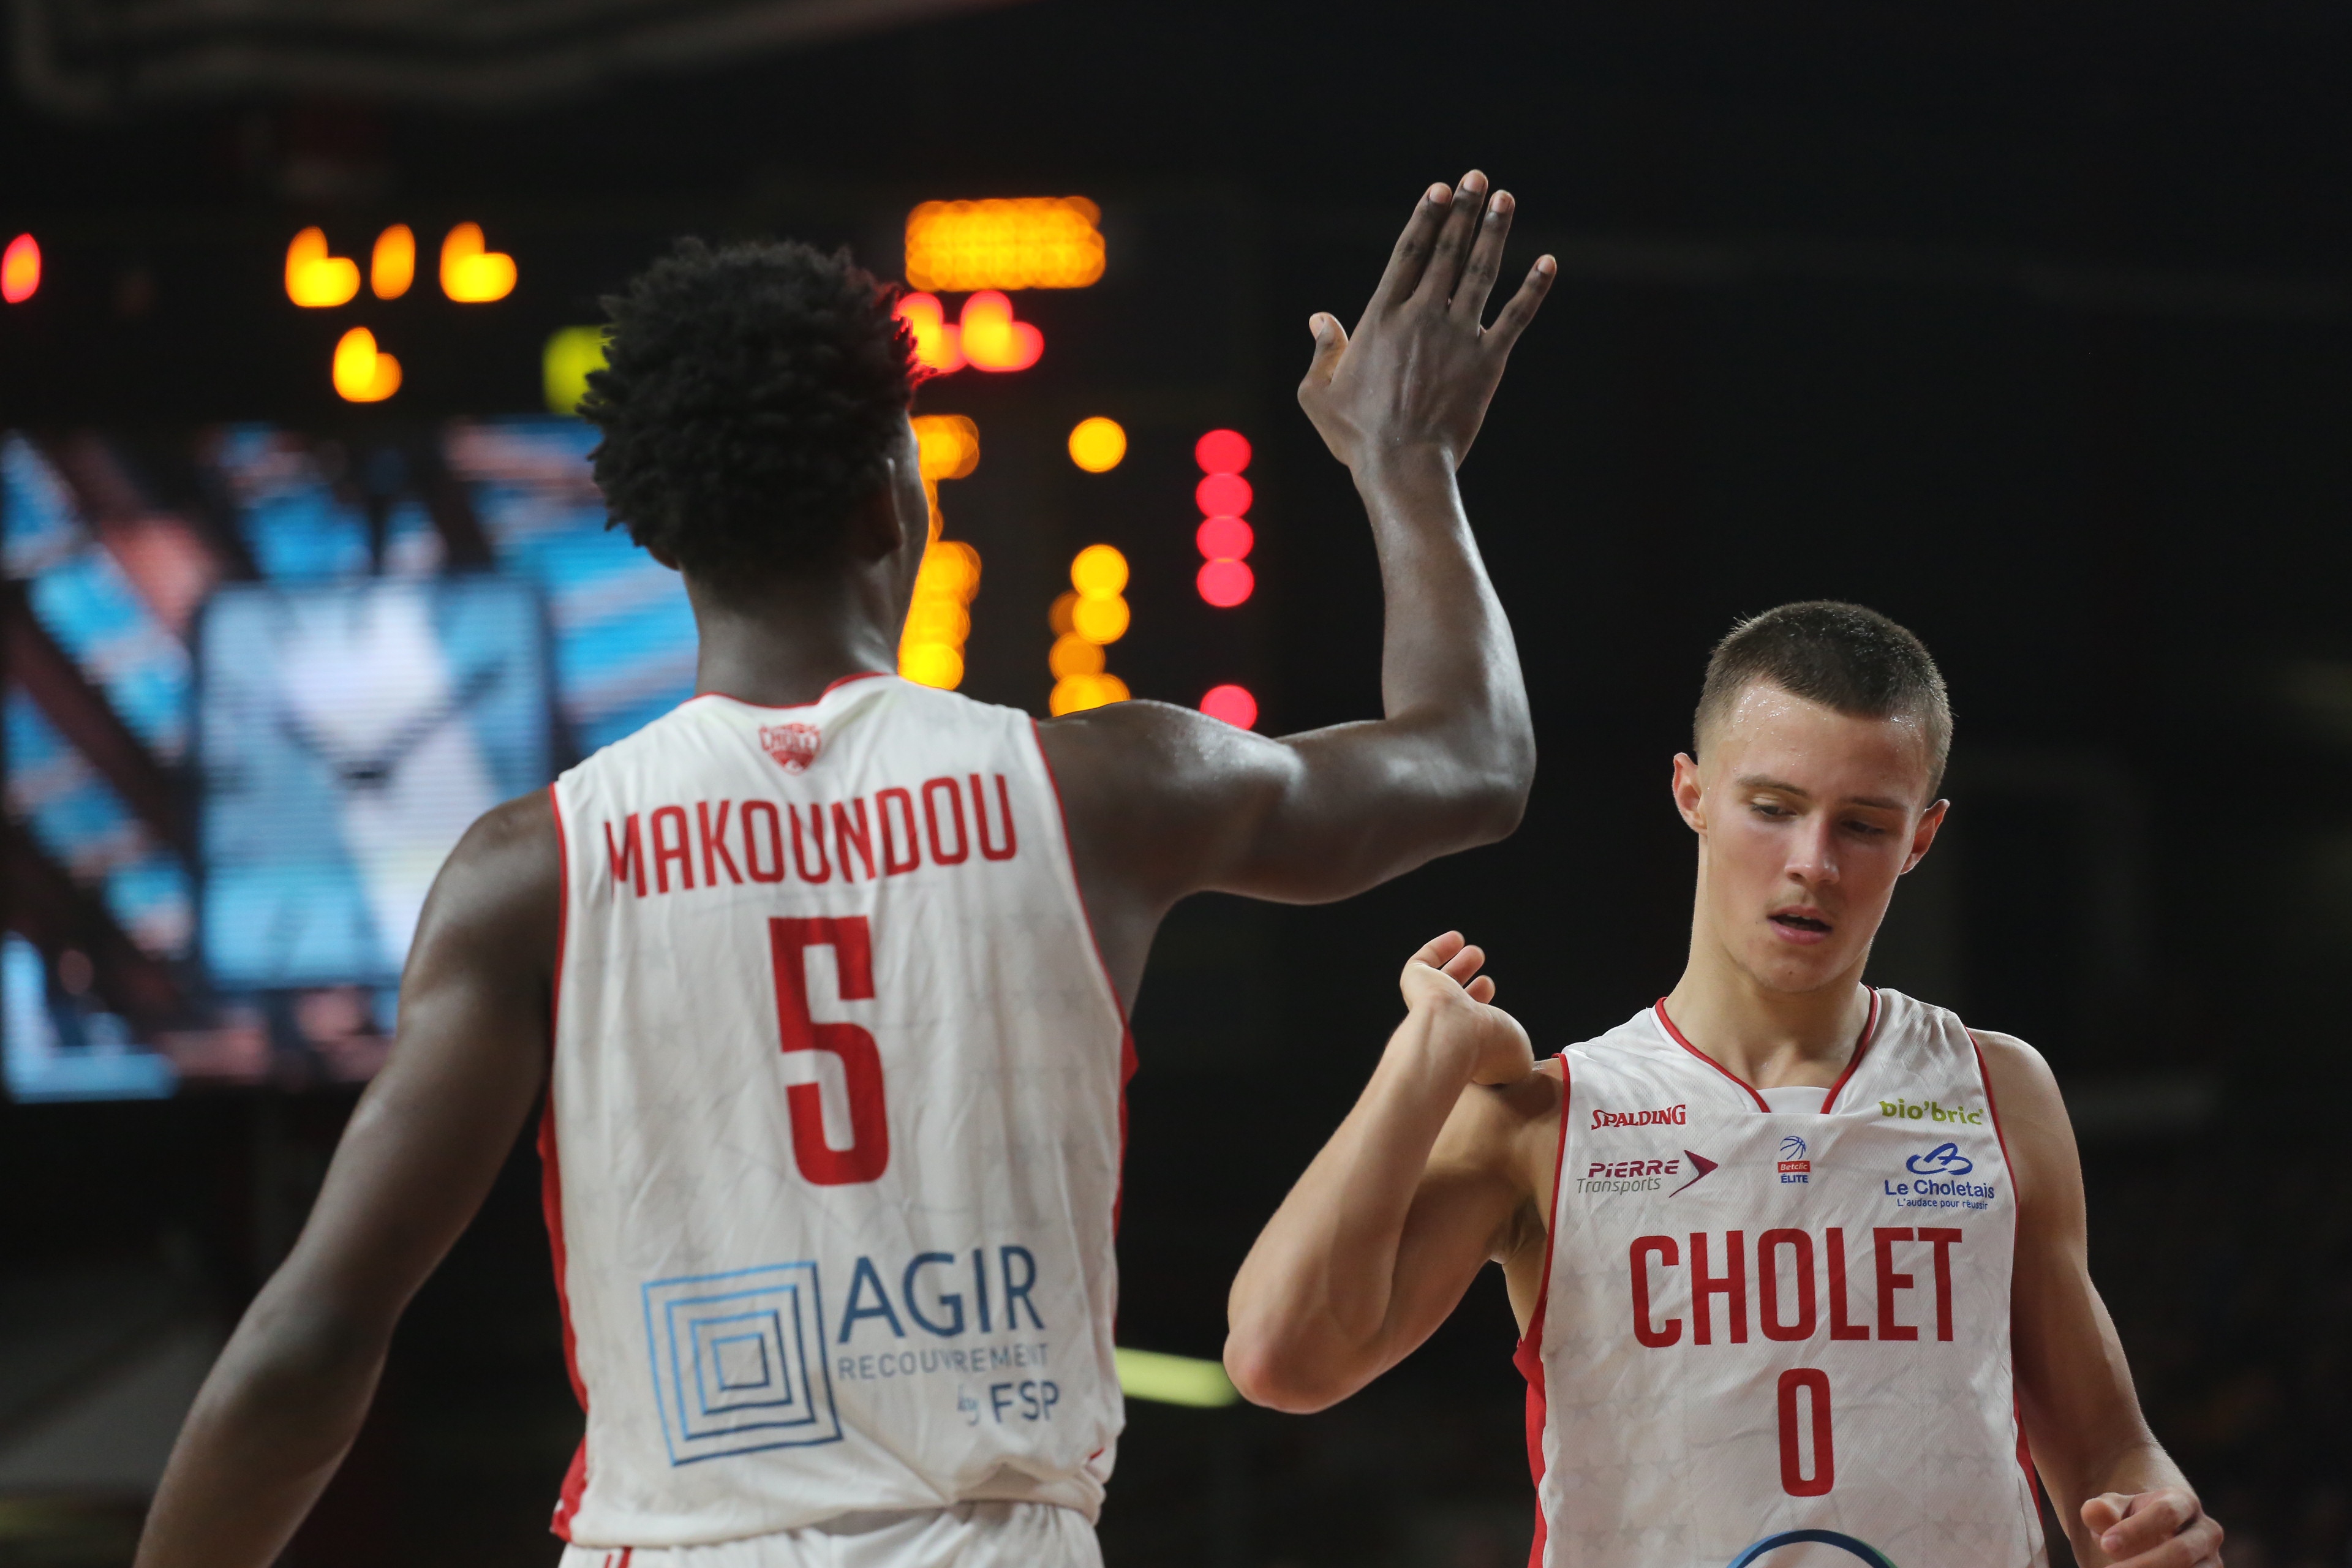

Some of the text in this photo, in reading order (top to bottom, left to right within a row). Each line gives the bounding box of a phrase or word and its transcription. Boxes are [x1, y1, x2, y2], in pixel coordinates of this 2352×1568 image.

[604, 773, 1018, 903] MAKOUNDOU
[769, 915, 891, 1186] 5
[1591, 1104, 1686, 1131] SPALDING
[1577, 1176, 1662, 1196] Transports
[1781, 1173, 1809, 1183] ÉLITE
[1885, 1179, 1995, 1199] Le Choletais
[1897, 1198, 1988, 1210] L'audace pour réussir
[837, 1245, 1045, 1344] AGIR
[1629, 1227, 1962, 1348] CHOLET
[989, 1380, 1060, 1423] FSP
[1777, 1368, 1834, 1497] 0
